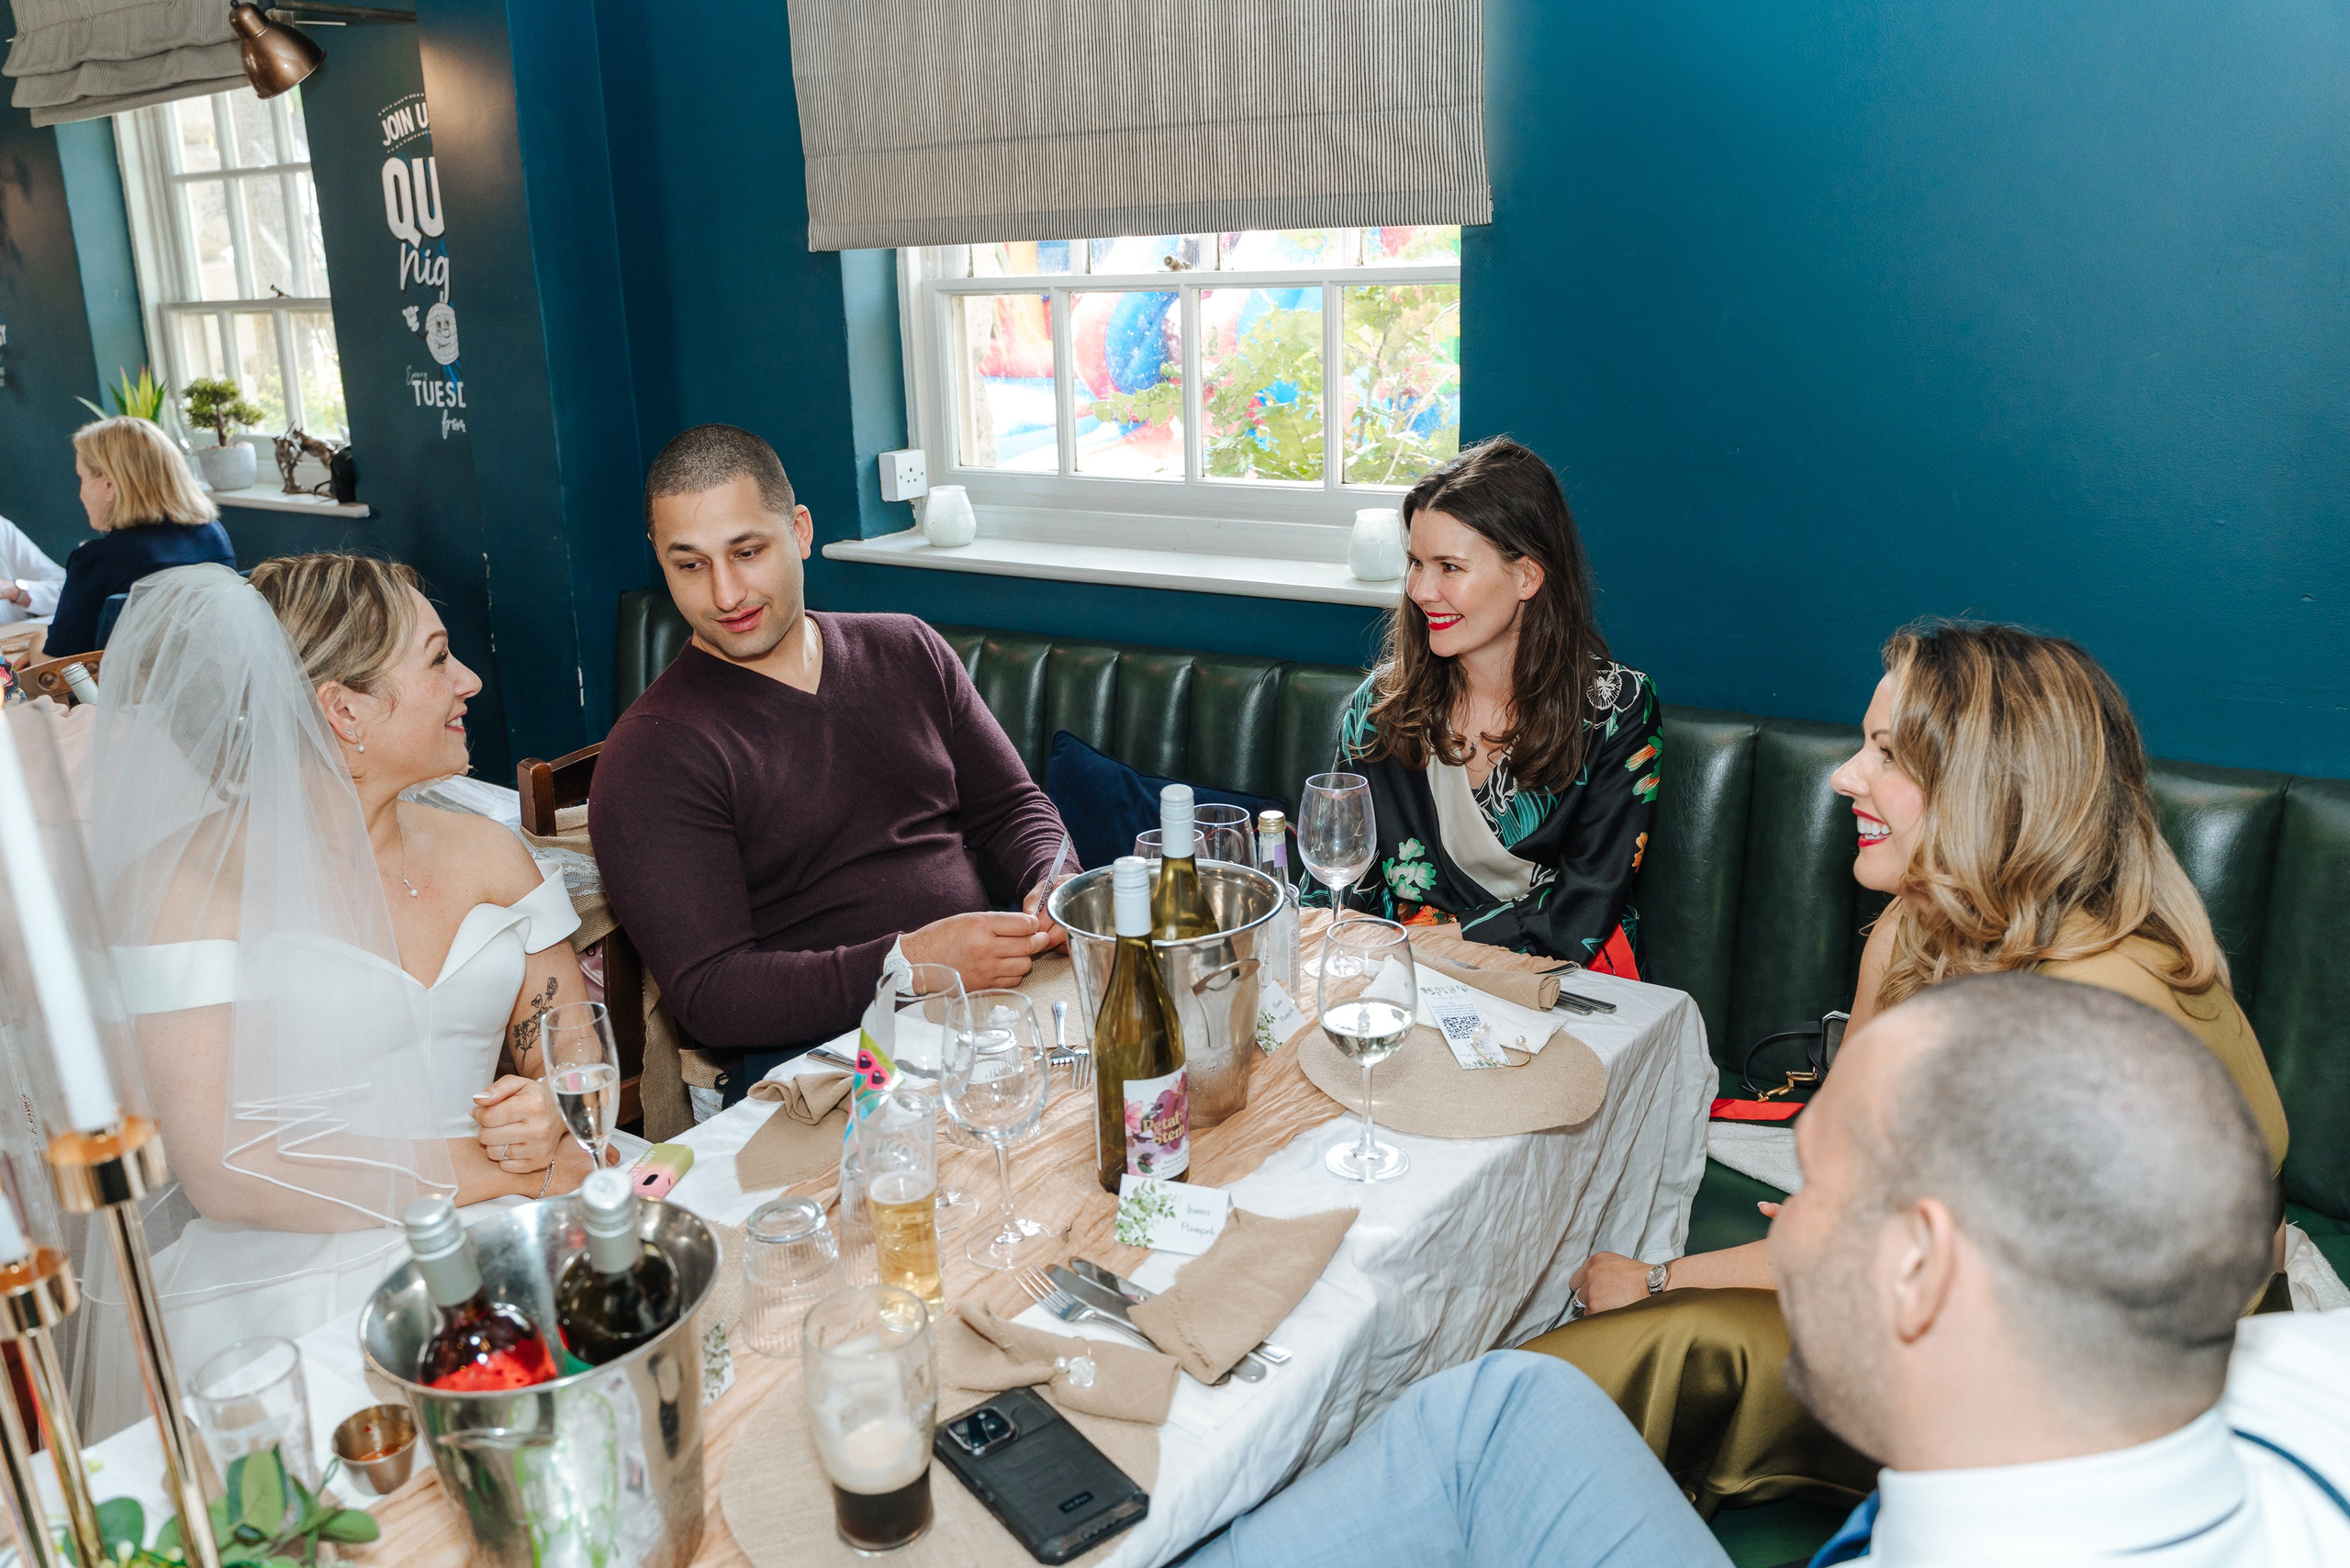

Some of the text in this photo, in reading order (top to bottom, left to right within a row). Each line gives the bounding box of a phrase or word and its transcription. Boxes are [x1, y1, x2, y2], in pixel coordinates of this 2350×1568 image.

[381, 101, 430, 147] JOIN U
[1142, 1110, 1180, 1133] Petal
[1150, 1124, 1185, 1146] Stem
